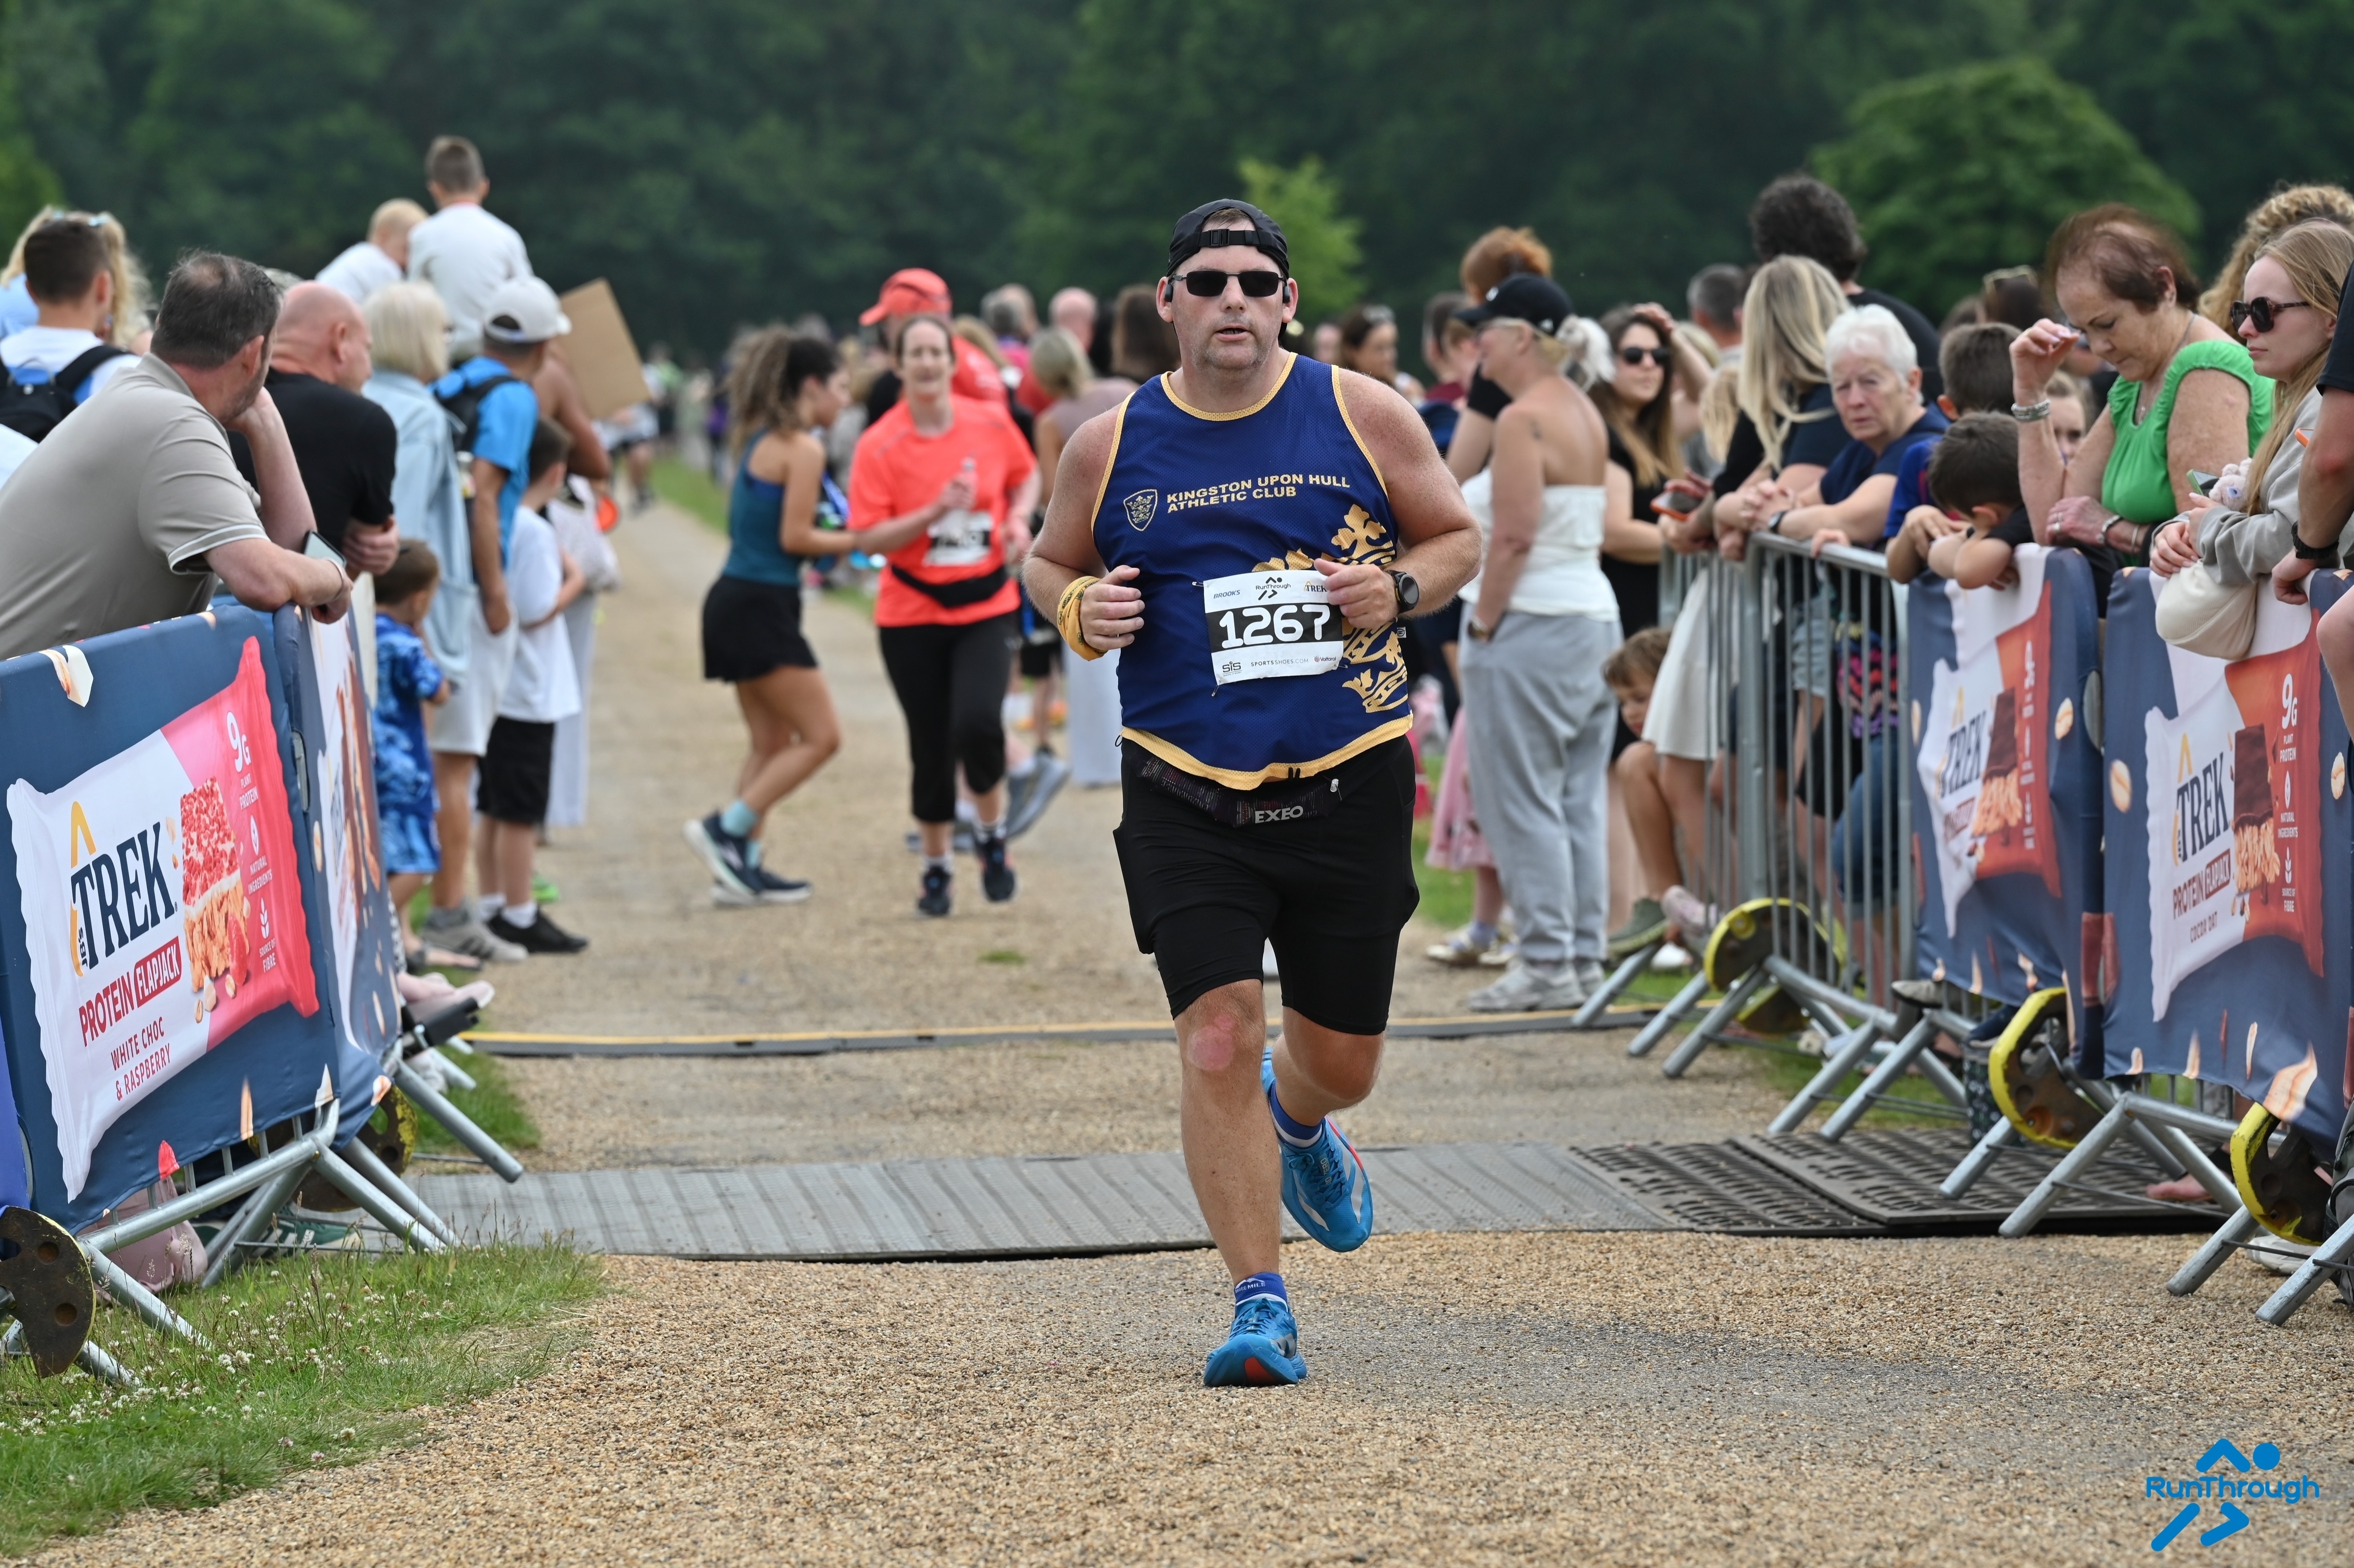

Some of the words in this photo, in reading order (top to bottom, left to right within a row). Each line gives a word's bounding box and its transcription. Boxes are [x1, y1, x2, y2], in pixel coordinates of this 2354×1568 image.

[1167, 479, 1252, 503] KINGSTON
[1258, 474, 1303, 487] UPON
[1309, 474, 1350, 488] HULL
[1167, 491, 1247, 513] ATHLETIC
[1252, 486, 1297, 499] CLUB
[1213, 590, 1240, 598] BROOKS
[1219, 604, 1330, 649] 1267
[2284, 734, 2293, 744] PLANT
[2280, 747, 2296, 763] PROTEIN
[240, 773, 252, 789] PLANT
[239, 786, 258, 811] PROTEIN
[2176, 751, 2229, 863] TREK
[1255, 805, 1303, 824] EXEO
[2280, 812, 2295, 823] NATURAL
[2278, 827, 2298, 838] INGREDIENTS
[250, 855, 268, 876] NATURAL
[248, 868, 273, 895] INGREDIENTS
[71, 821, 175, 970] TREK
[2173, 870, 2204, 920] PROTEIN
[2284, 900, 2294, 912] FIBRE
[2190, 919, 2207, 943] COCOA
[259, 940, 271, 958] SOURCE
[263, 952, 277, 973] FIBRE
[79, 972, 134, 1047] PROTEIN
[136, 944, 180, 1000] FLAPJACK
[111, 1034, 140, 1071] WHITE
[141, 1016, 164, 1049] CHOC
[115, 1080, 123, 1101] &
[124, 1043, 171, 1095] RASPBERRY
